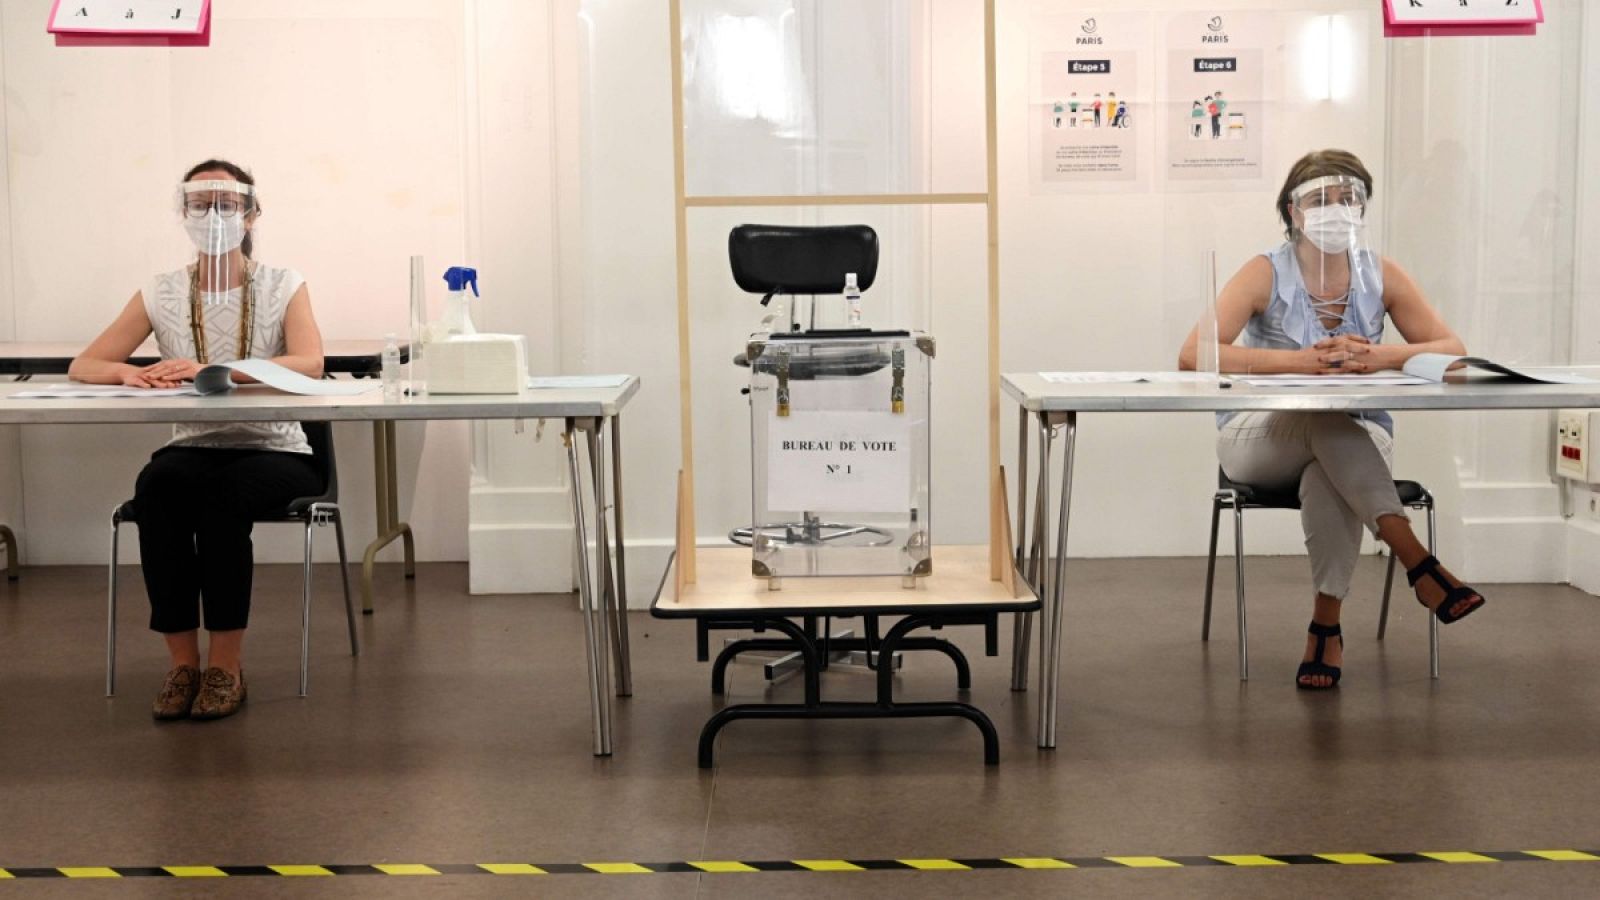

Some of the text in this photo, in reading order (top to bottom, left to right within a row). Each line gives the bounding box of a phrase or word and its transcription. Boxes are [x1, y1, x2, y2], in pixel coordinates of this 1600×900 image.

[75, 7, 88, 16] A
[171, 8, 181, 19] J
[1076, 37, 1103, 45] PARIS
[1202, 35, 1228, 43] PARIS
[1072, 61, 1098, 73] Étape
[1199, 59, 1224, 72] Étape
[782, 440, 896, 451] BUREAU DE VOTE
[826, 464, 841, 474] N°
